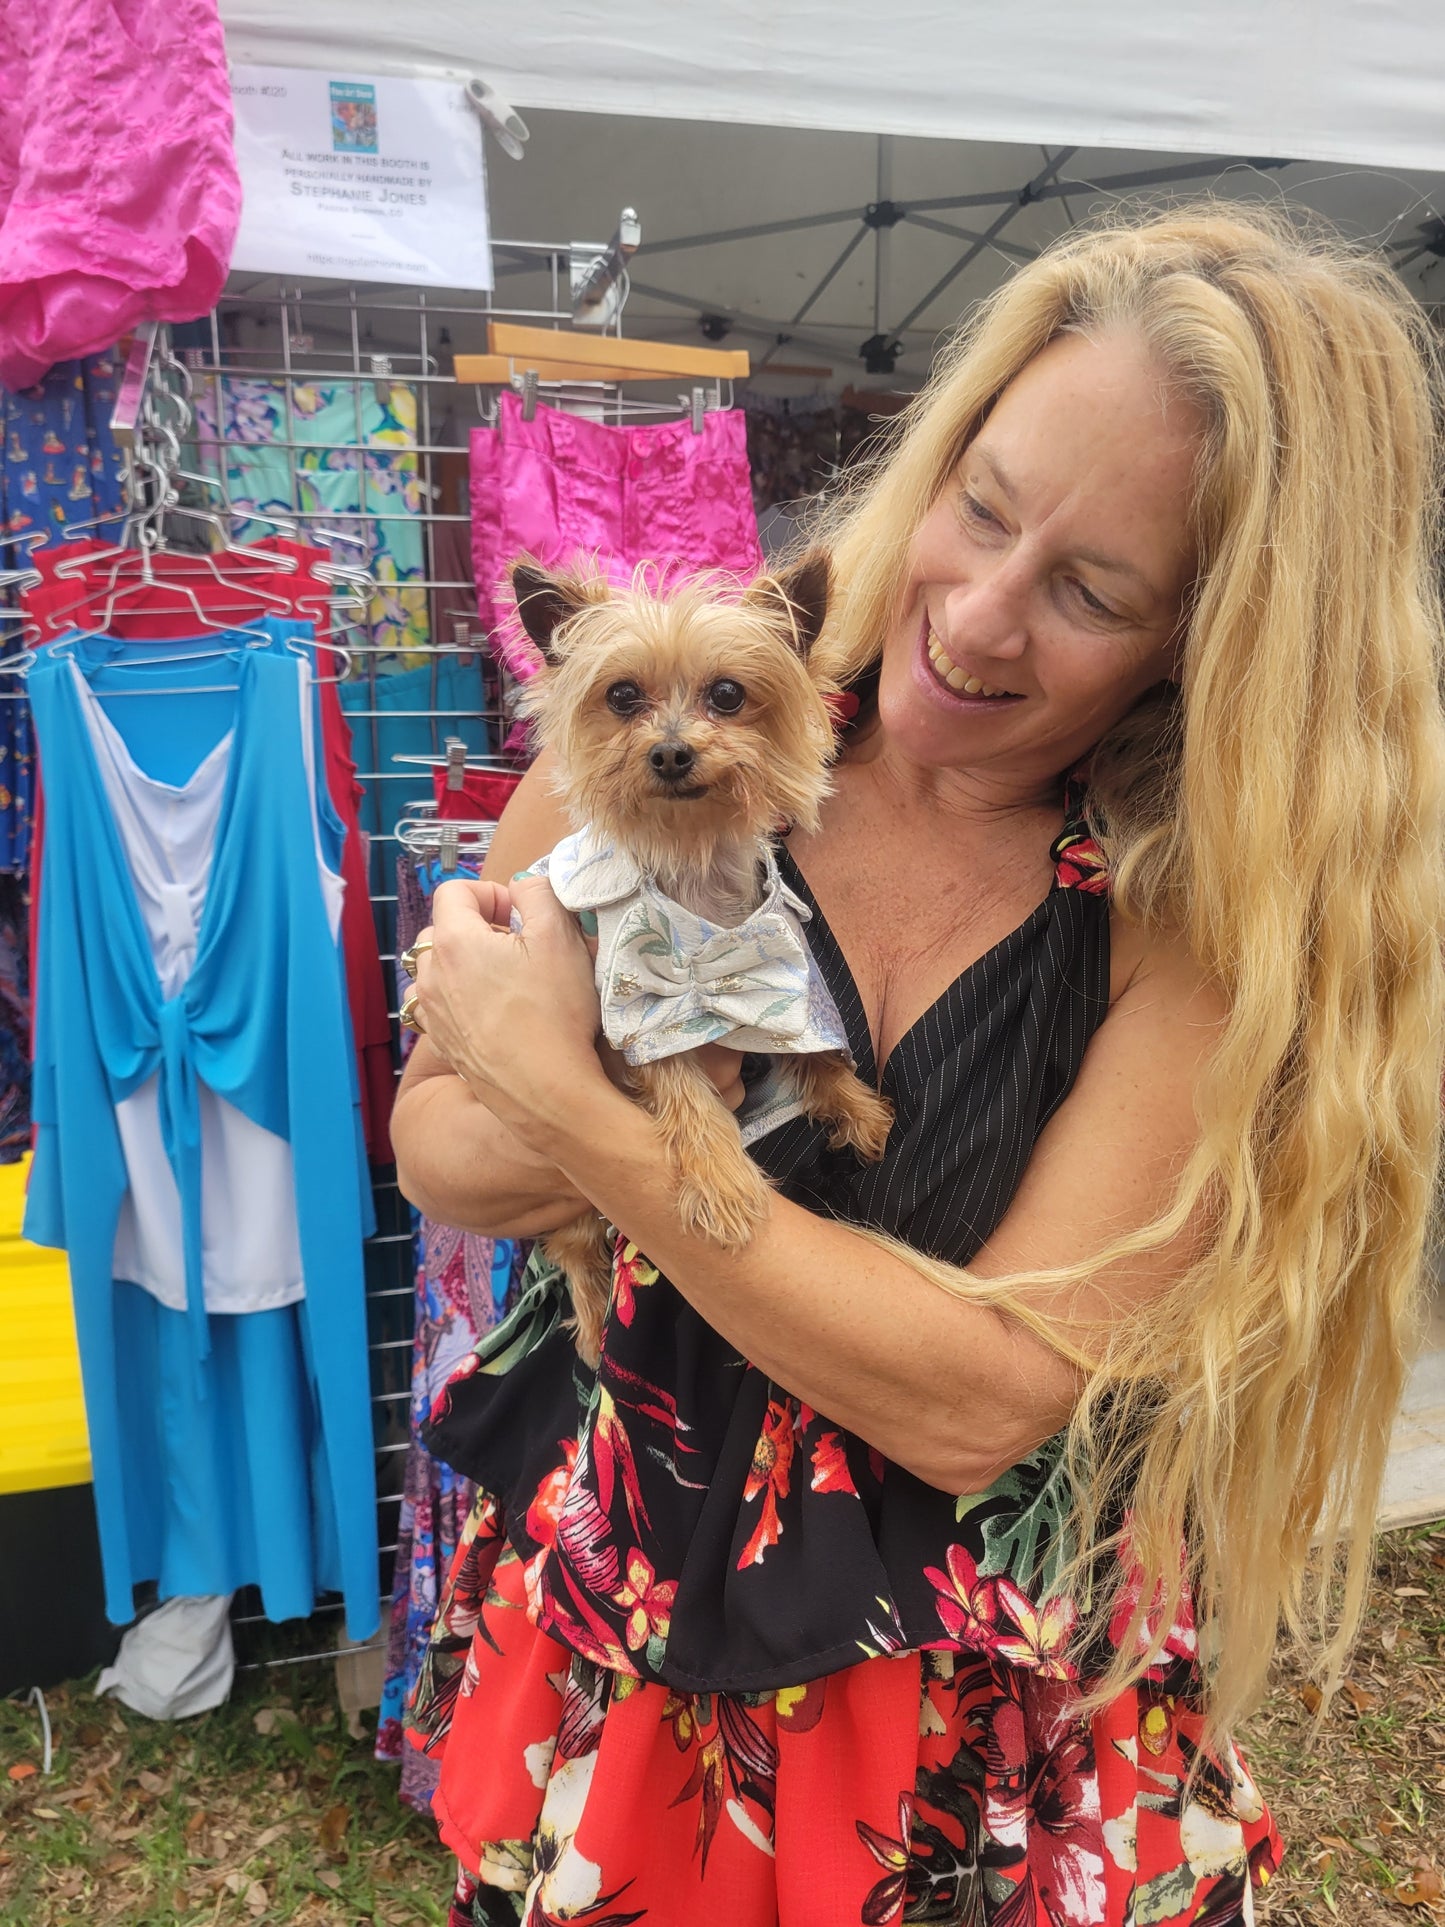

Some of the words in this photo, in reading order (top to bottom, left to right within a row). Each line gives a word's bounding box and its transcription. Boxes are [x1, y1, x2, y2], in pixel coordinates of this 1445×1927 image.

[306, 153, 338, 164] WORK
[342, 156, 353, 165] IN
[355, 156, 378, 168] THIS
[380, 158, 418, 170] BOOTH
[420, 160, 431, 171] IS
[356, 173, 415, 186] HANDMADE
[418, 178, 433, 189] BY
[290, 181, 373, 202] STEPHANIE
[378, 188, 428, 206] JONES
